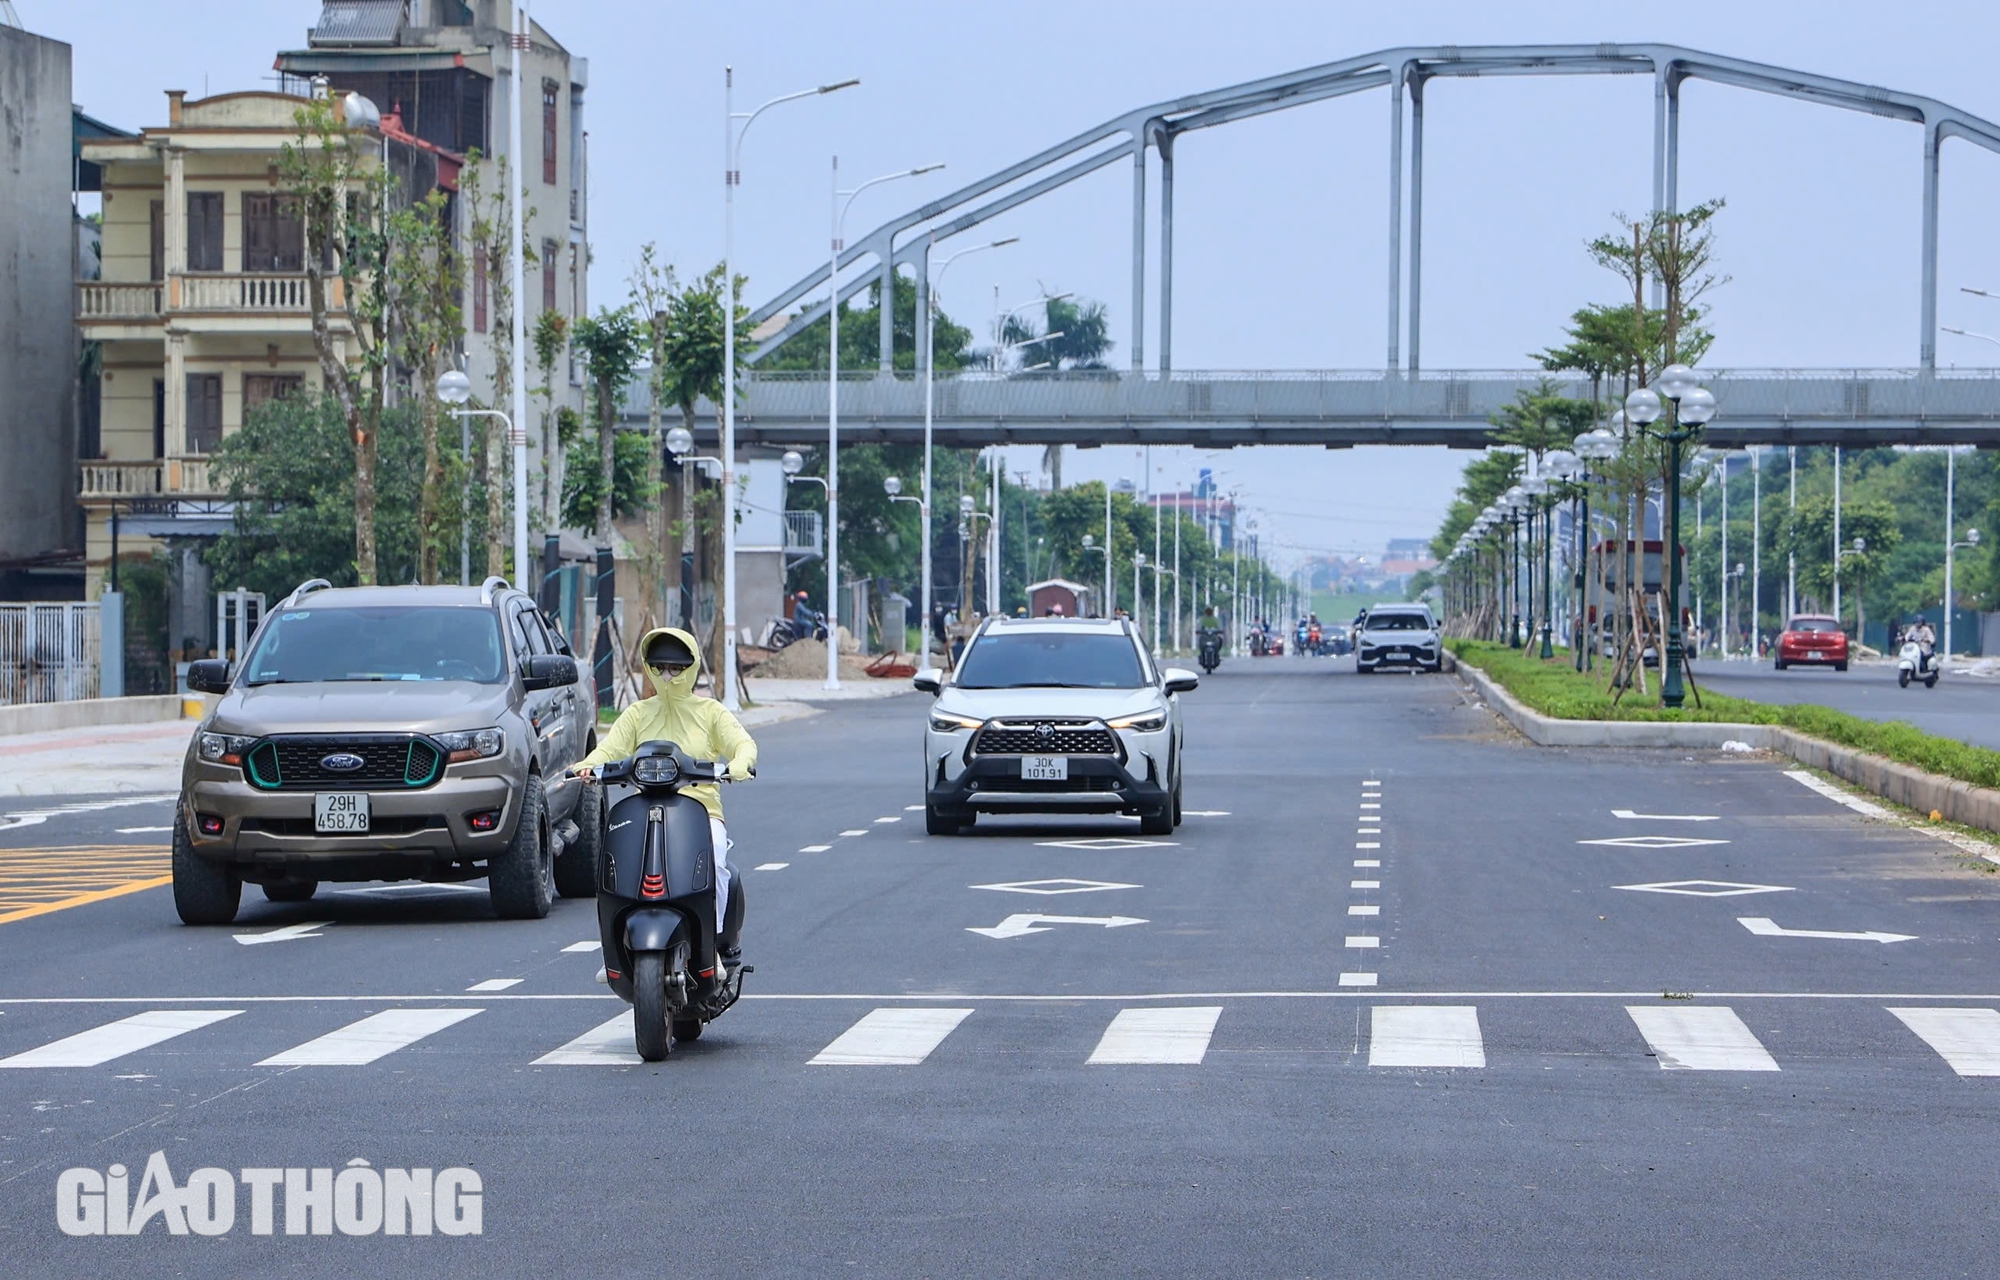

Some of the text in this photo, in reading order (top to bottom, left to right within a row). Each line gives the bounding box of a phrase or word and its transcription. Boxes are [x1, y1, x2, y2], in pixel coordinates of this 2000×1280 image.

[330, 756, 354, 767] Ford
[1035, 757, 1054, 767] 30K
[1028, 768, 1062, 778] 101.91
[328, 795, 356, 811] 29H
[317, 812, 367, 829] 458.78
